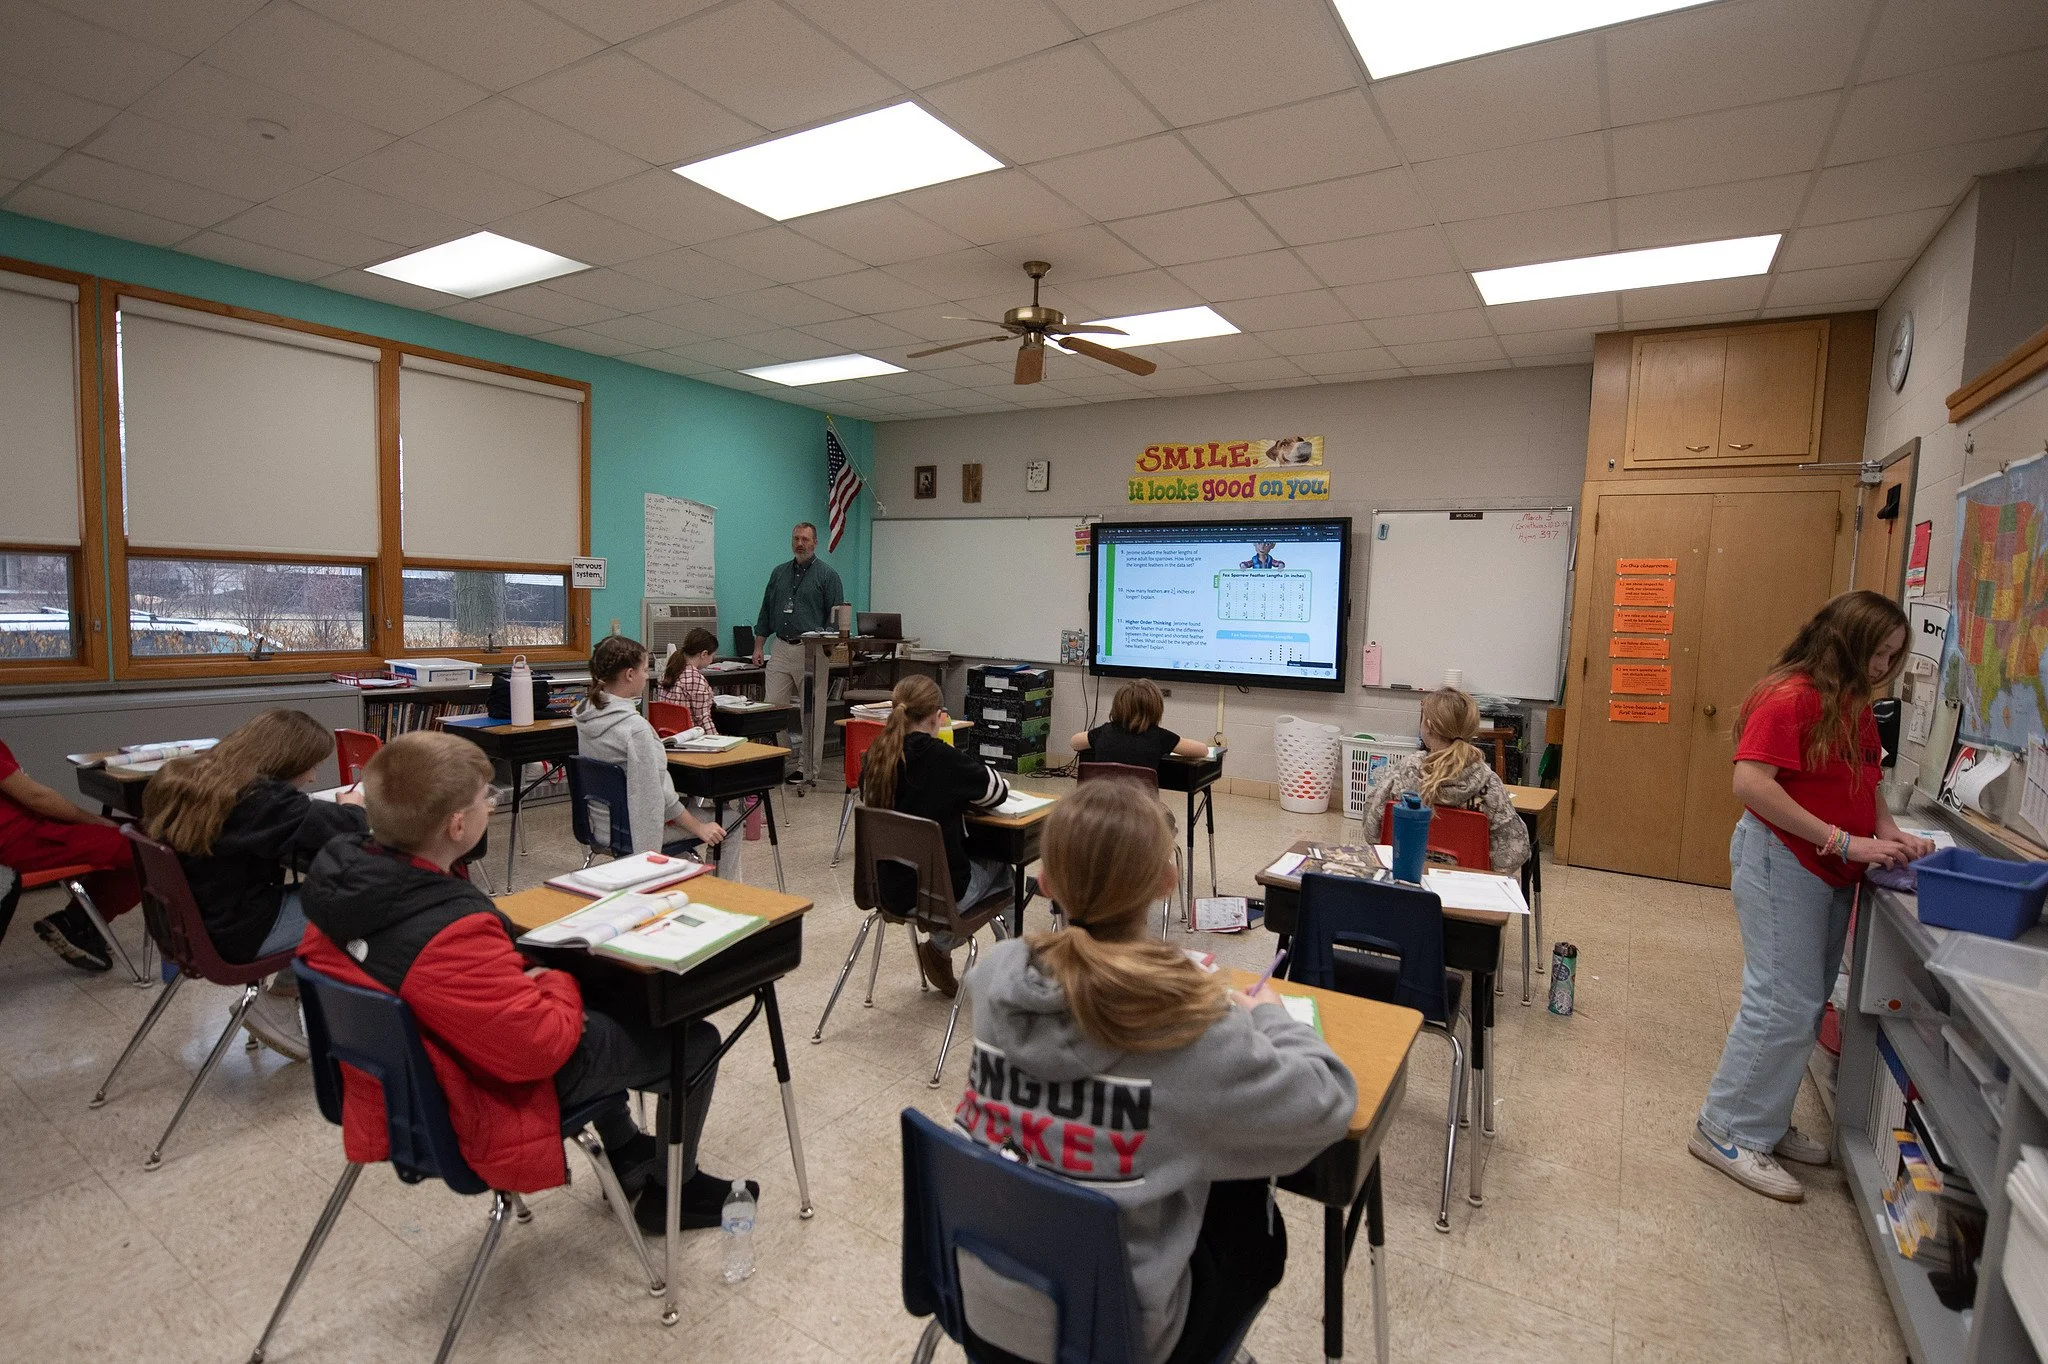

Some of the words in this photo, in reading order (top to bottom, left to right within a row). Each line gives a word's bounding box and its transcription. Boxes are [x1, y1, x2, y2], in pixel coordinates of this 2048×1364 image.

[1136, 442, 1258, 472] SMILE.
[1128, 480, 1143, 500] It
[1148, 478, 1199, 500] looks
[1202, 474, 1256, 501] good
[1259, 479, 1284, 496] on
[1286, 479, 1328, 500] you.
[1540, 530, 1559, 540] 397
